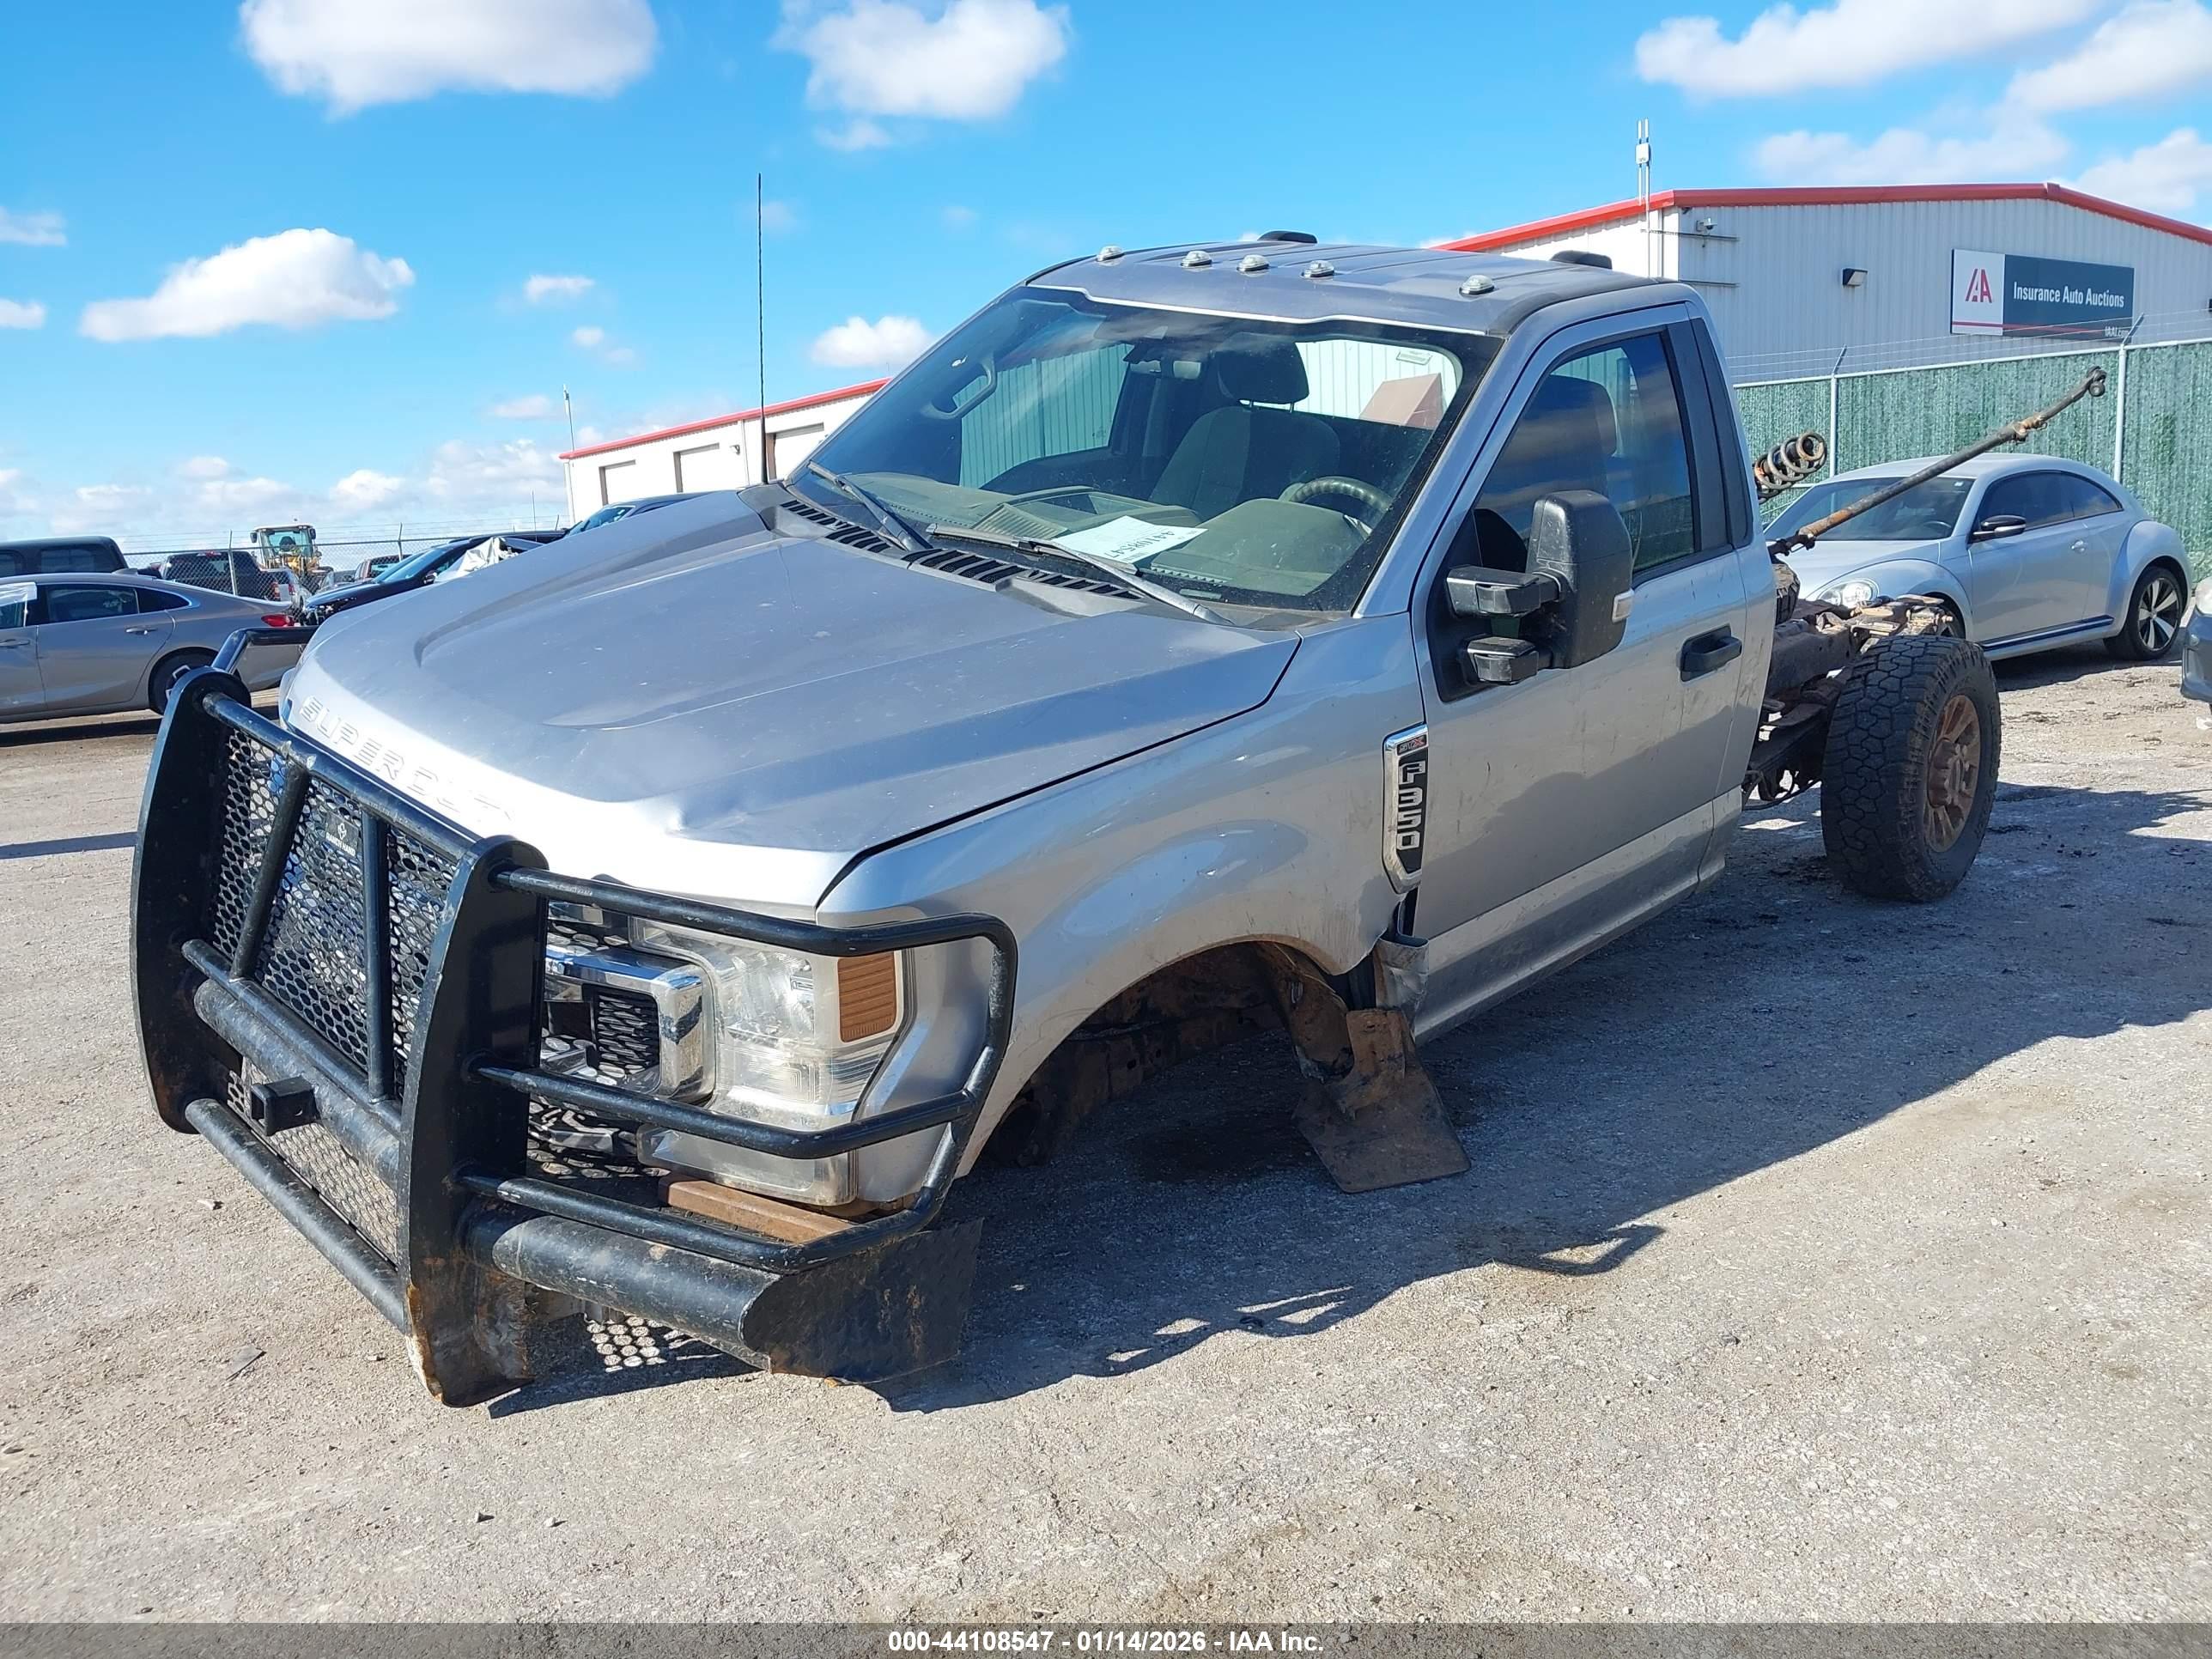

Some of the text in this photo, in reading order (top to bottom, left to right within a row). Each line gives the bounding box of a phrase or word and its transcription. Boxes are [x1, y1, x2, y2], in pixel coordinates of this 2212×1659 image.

[2014, 282, 2124, 308] Insurance Auto Auctions
[301, 696, 404, 781] SUPER
[1397, 761, 1425, 850] F350
[325, 831, 356, 857] RANCH HAND
